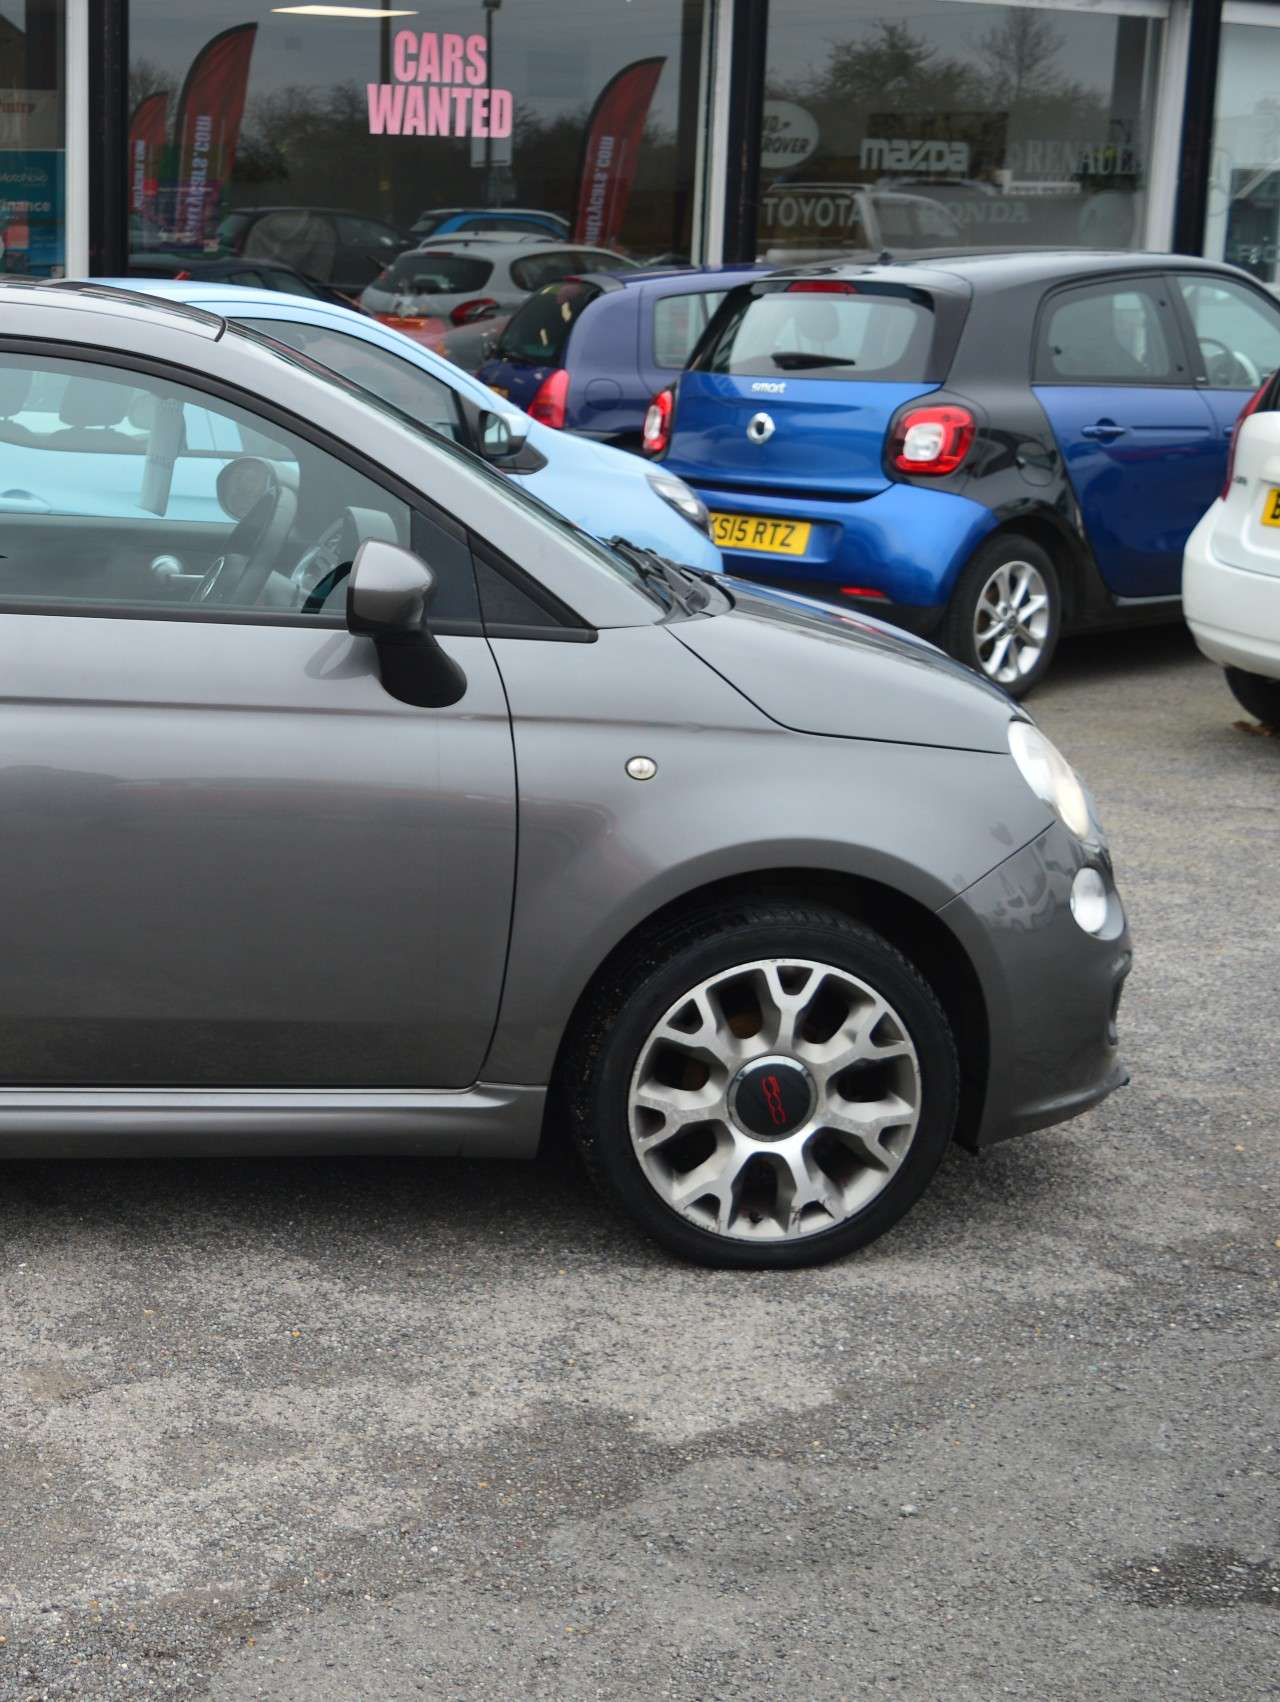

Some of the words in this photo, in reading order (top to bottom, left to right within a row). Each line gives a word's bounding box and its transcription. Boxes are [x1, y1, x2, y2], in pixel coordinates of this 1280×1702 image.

[393, 29, 488, 86] CARS
[366, 82, 513, 139] WANTED
[763, 197, 864, 227] TOYOTA
[751, 382, 787, 394] smart
[752, 521, 797, 547] RTZ
